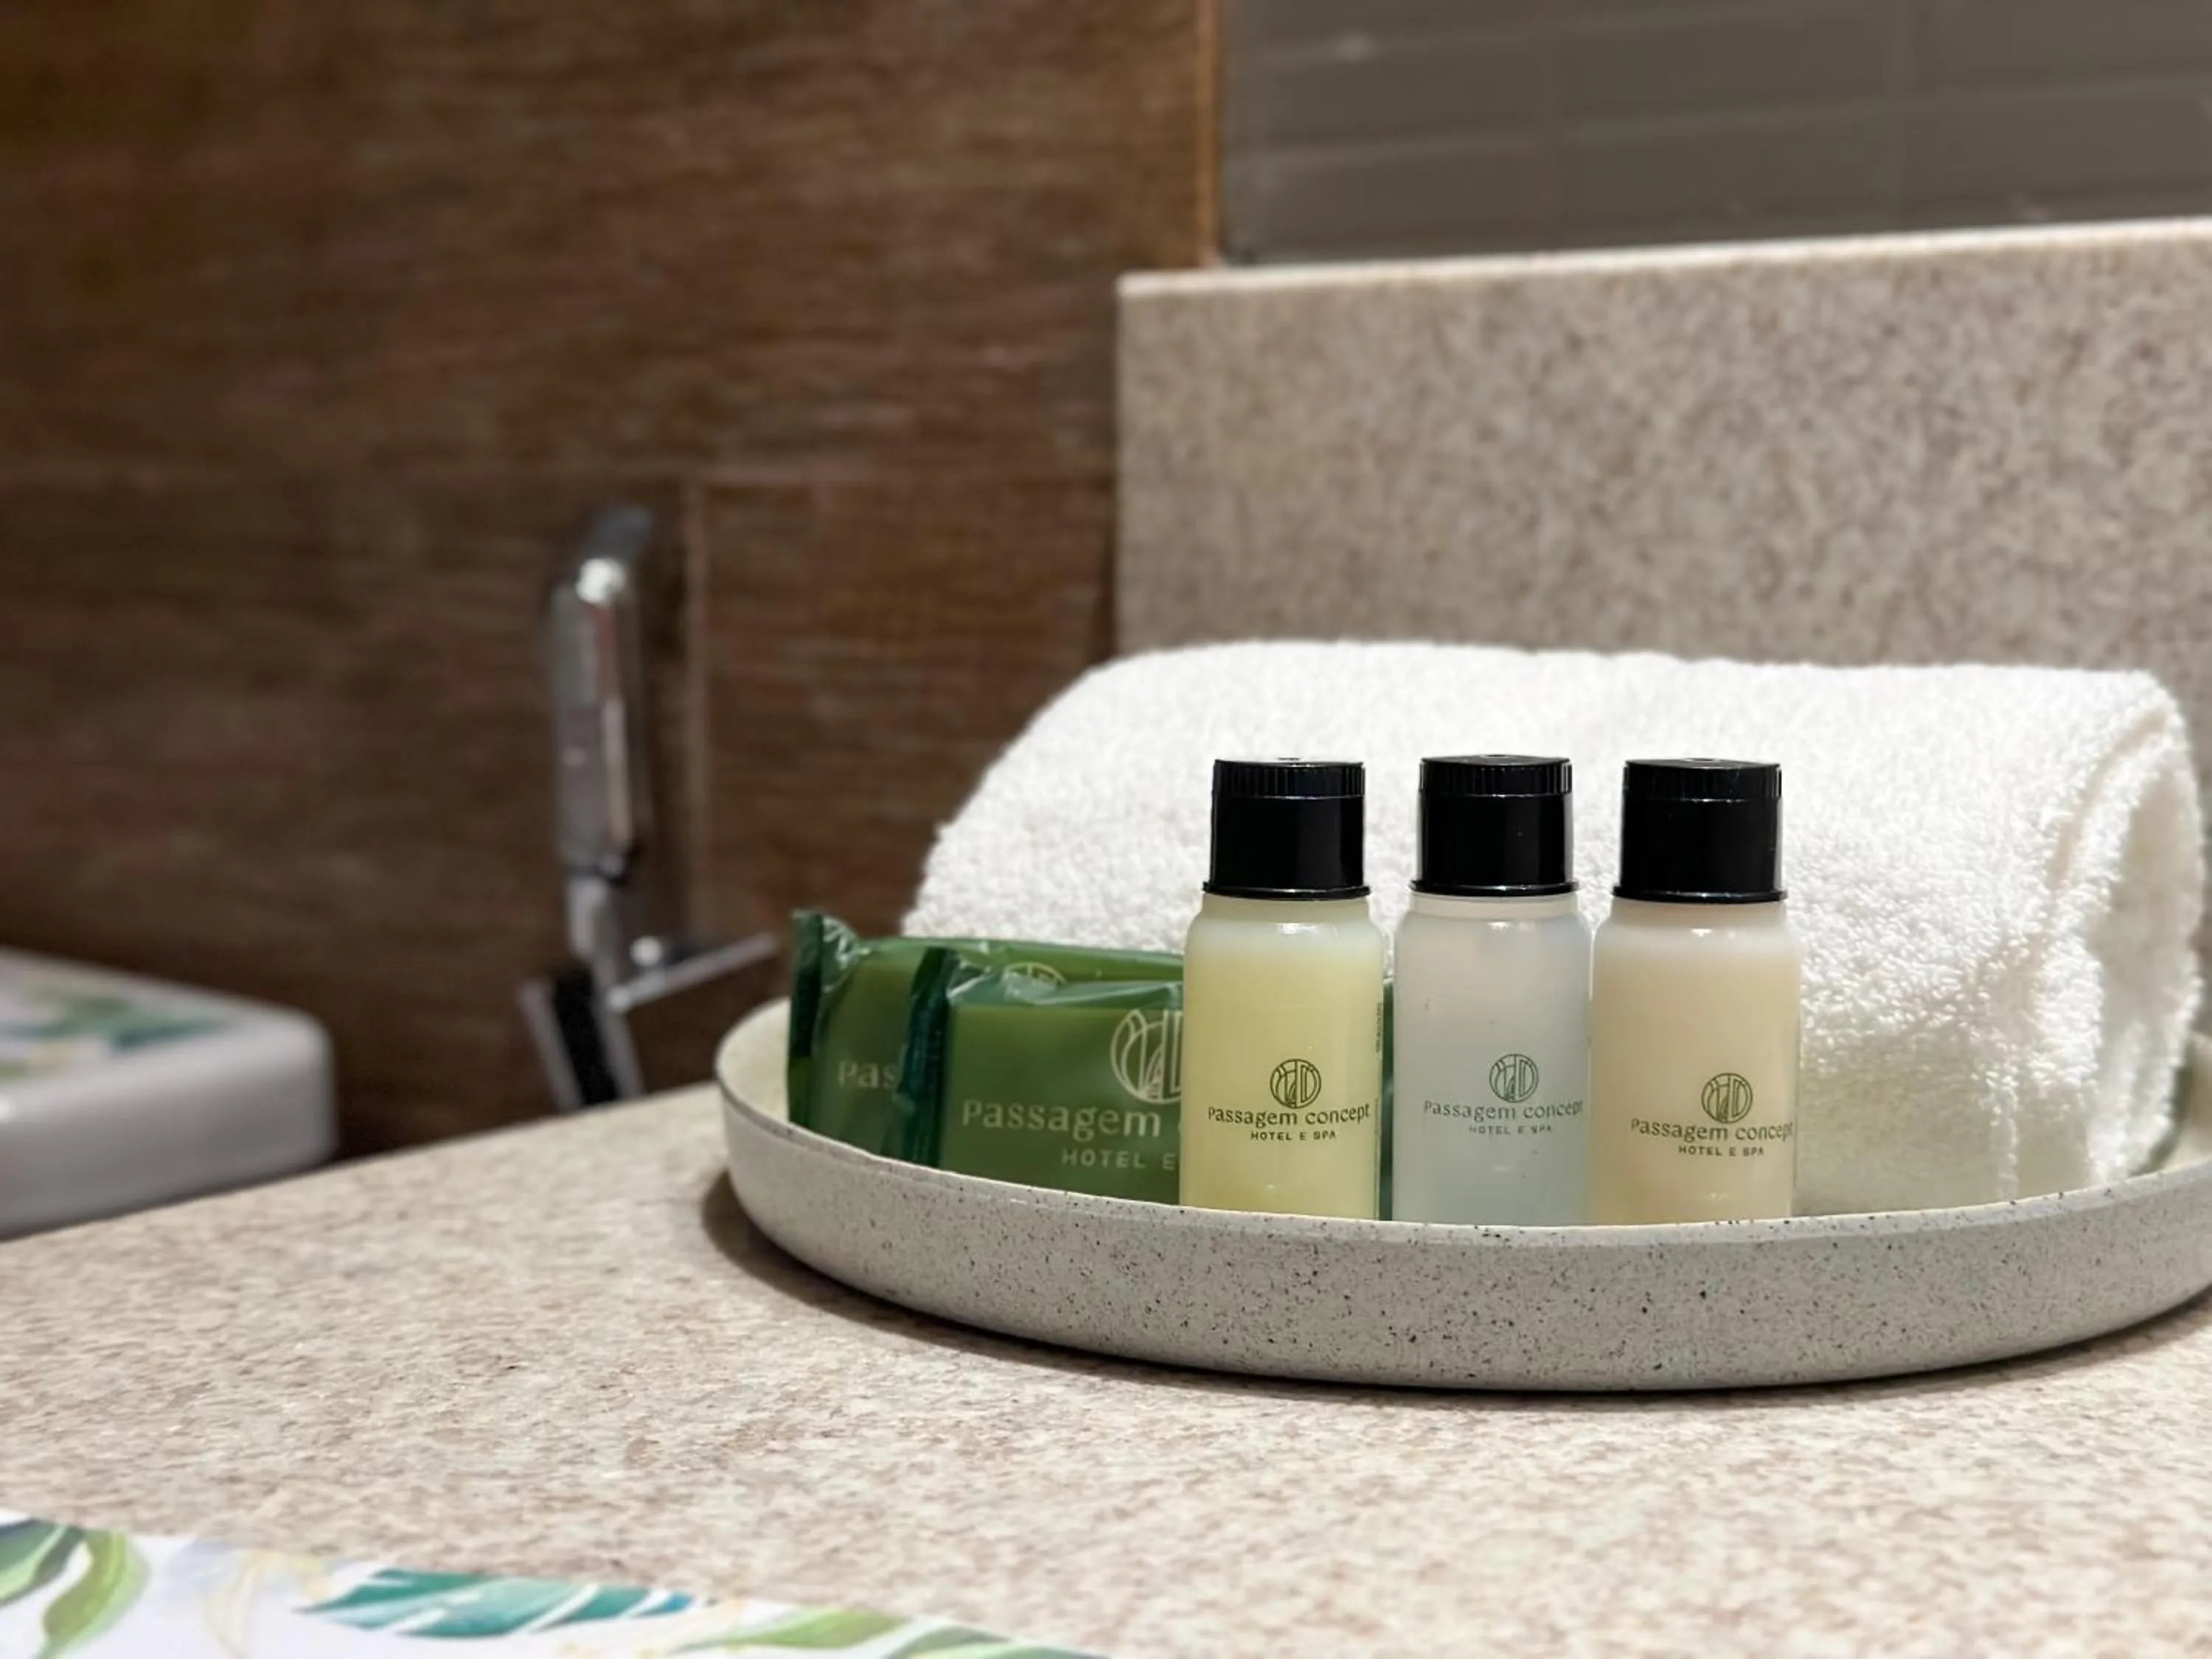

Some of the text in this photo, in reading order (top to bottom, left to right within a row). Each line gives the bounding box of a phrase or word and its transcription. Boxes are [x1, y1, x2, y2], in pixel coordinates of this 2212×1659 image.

[962, 1099, 1161, 1143] Passagem
[1208, 1106, 1298, 1129] Passagem
[1305, 1103, 1371, 1125] concept
[1423, 1099, 1584, 1122] Passagem concept
[1251, 1130, 1337, 1141] HOTEL E SPA
[1468, 1124, 1553, 1135] HOTEL E SPA
[1630, 1118, 1795, 1143] Passagem concept
[1062, 1148, 1178, 1171] HOTEL E
[1678, 1146, 1764, 1157] HOTEL E SPA
